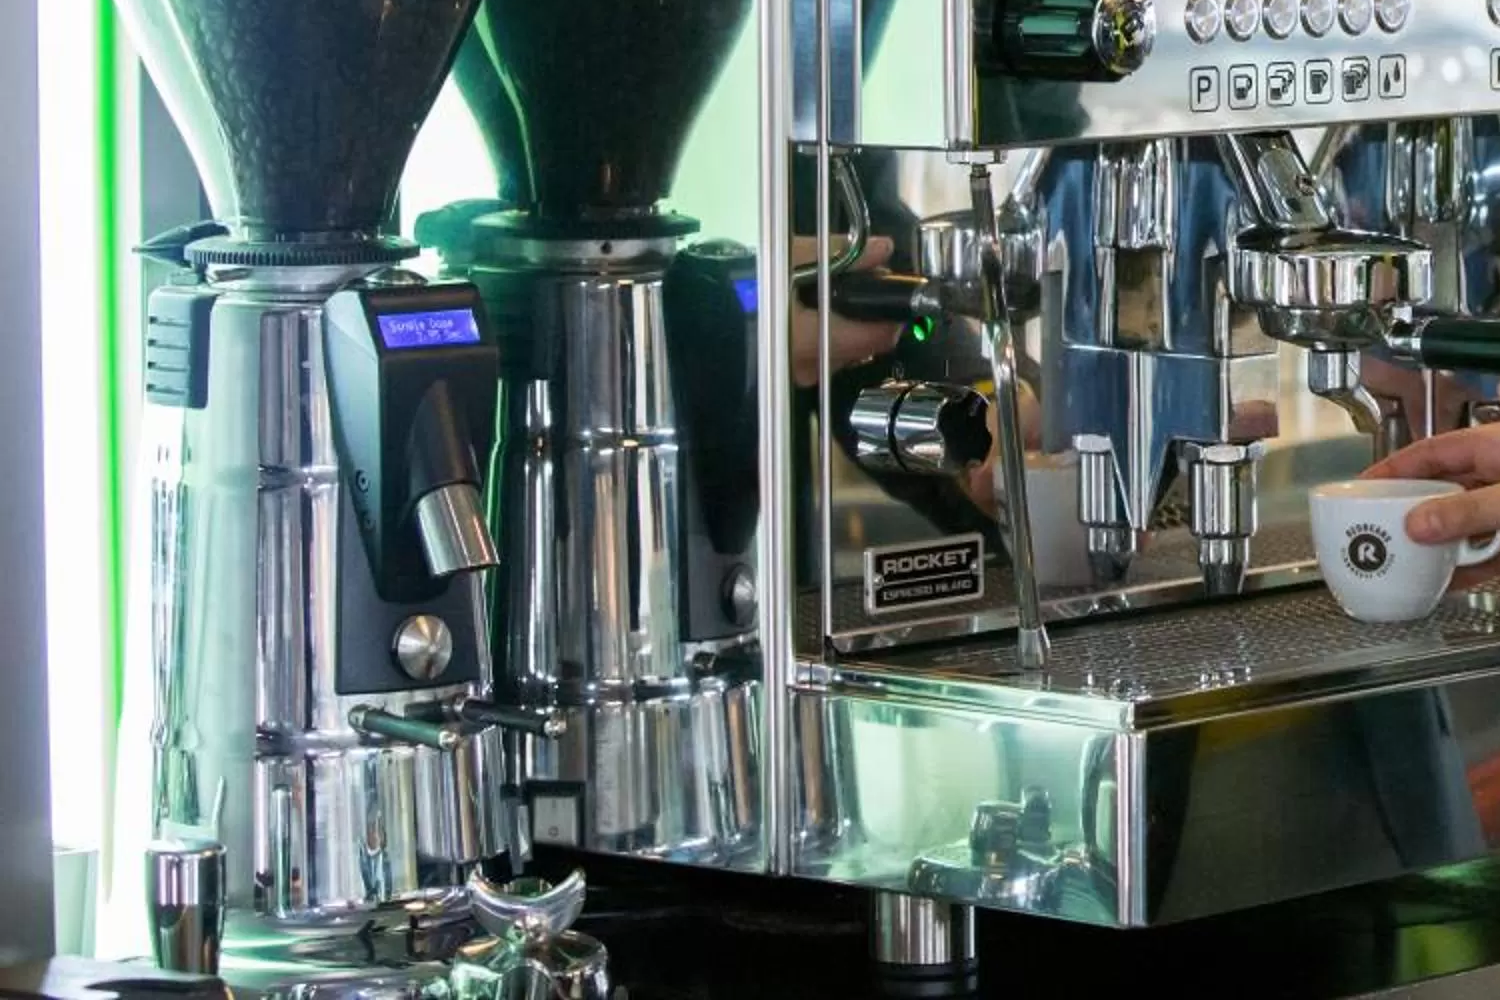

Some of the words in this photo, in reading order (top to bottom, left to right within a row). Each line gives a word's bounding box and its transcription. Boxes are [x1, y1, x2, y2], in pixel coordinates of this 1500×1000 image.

[1197, 76, 1212, 104] P
[882, 548, 971, 575] ROCKET
[1357, 542, 1380, 562] R
